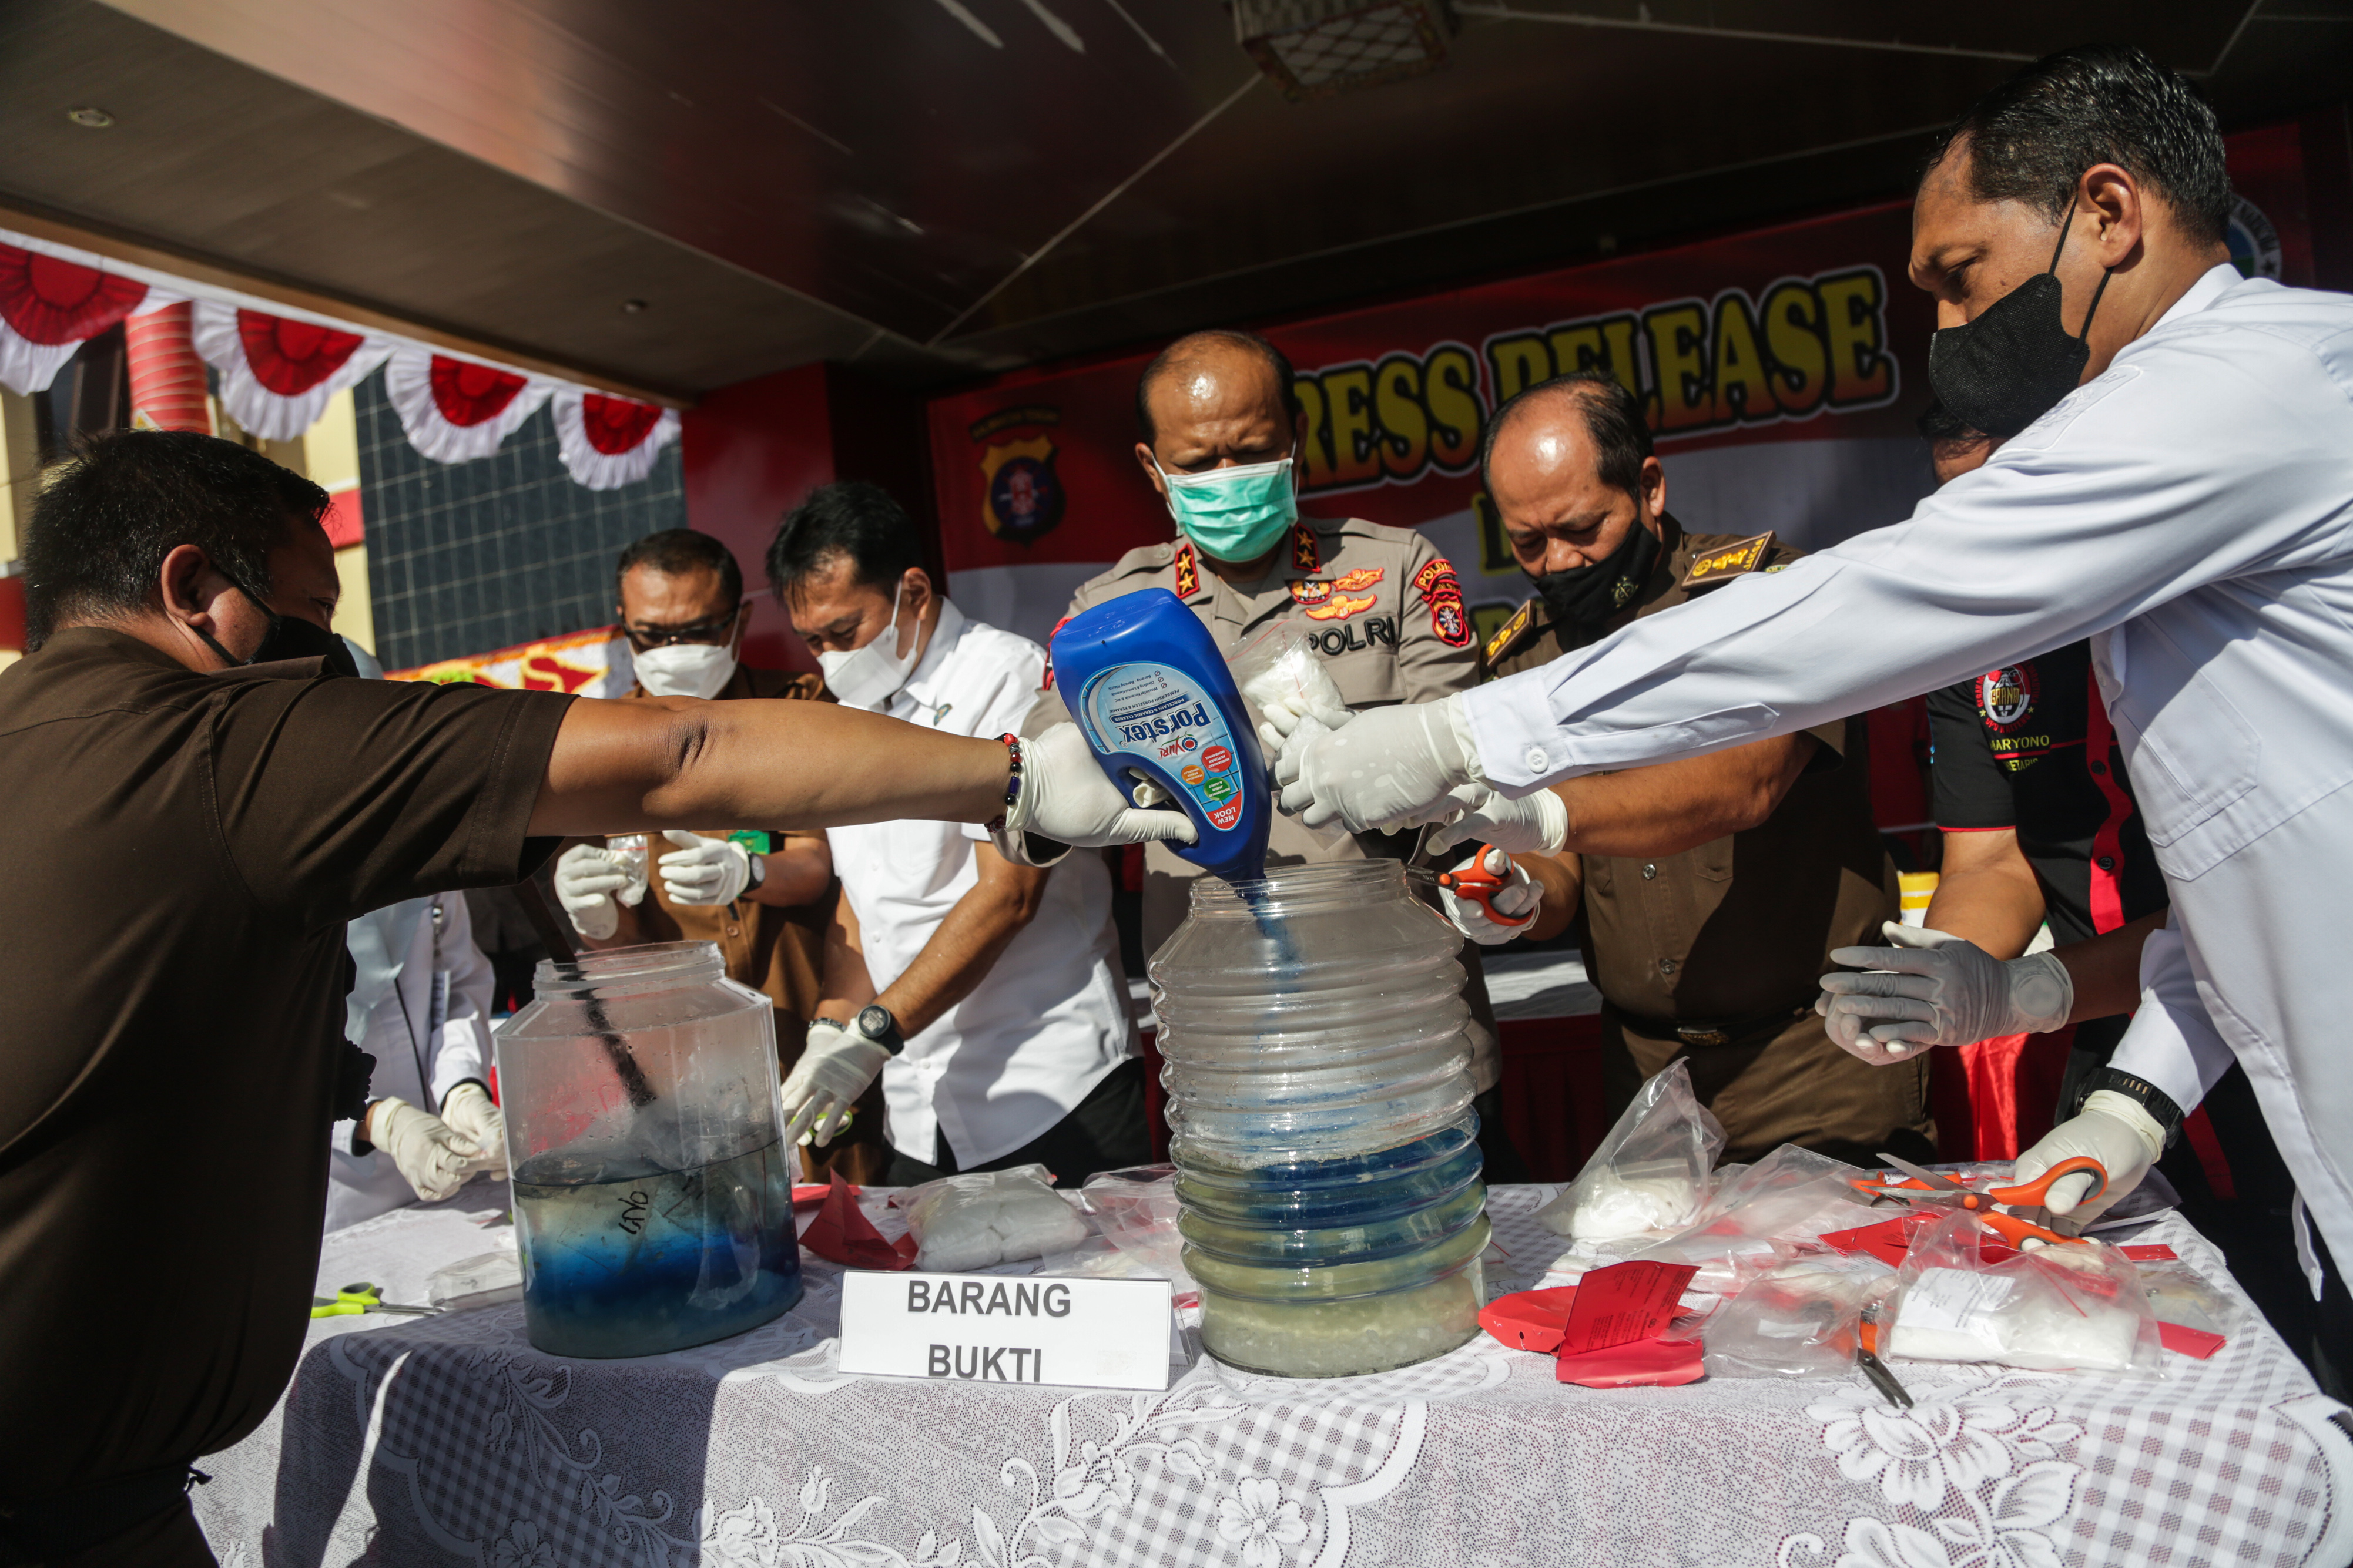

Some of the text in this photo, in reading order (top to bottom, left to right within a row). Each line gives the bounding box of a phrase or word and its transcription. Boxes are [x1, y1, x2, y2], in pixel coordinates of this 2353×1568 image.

[1293, 347, 1486, 491] RESS
[1743, 538, 1765, 570] JAKSA
[1136, 674, 1151, 683] Barang
[1139, 680, 1155, 689] Dinding
[1124, 692, 1141, 700] Keramik
[1141, 686, 1158, 696] Wastafel
[1154, 689, 1179, 701] PEMBERSIH
[1990, 687, 2020, 706] GRANAT
[1132, 697, 1154, 709] PORSELEN
[1158, 697, 1185, 711] PORCELAIN
[1109, 706, 1127, 714] KERAMIK
[1134, 709, 1154, 718] CERAMIC
[1114, 714, 1134, 722] CLEANER
[1118, 701, 1211, 743] Porstex
[1205, 750, 1225, 760] MEMBANDEL
[1208, 754, 1226, 763] KOTORAN
[1208, 757, 1230, 768] MENGANGKAT
[1209, 787, 1230, 797] MENGANGKAT
[1214, 806, 1236, 819] LOOK
[1218, 814, 1235, 825] NEW
[907, 1280, 1071, 1318] BARANG
[927, 1344, 1042, 1383] BUKTI
